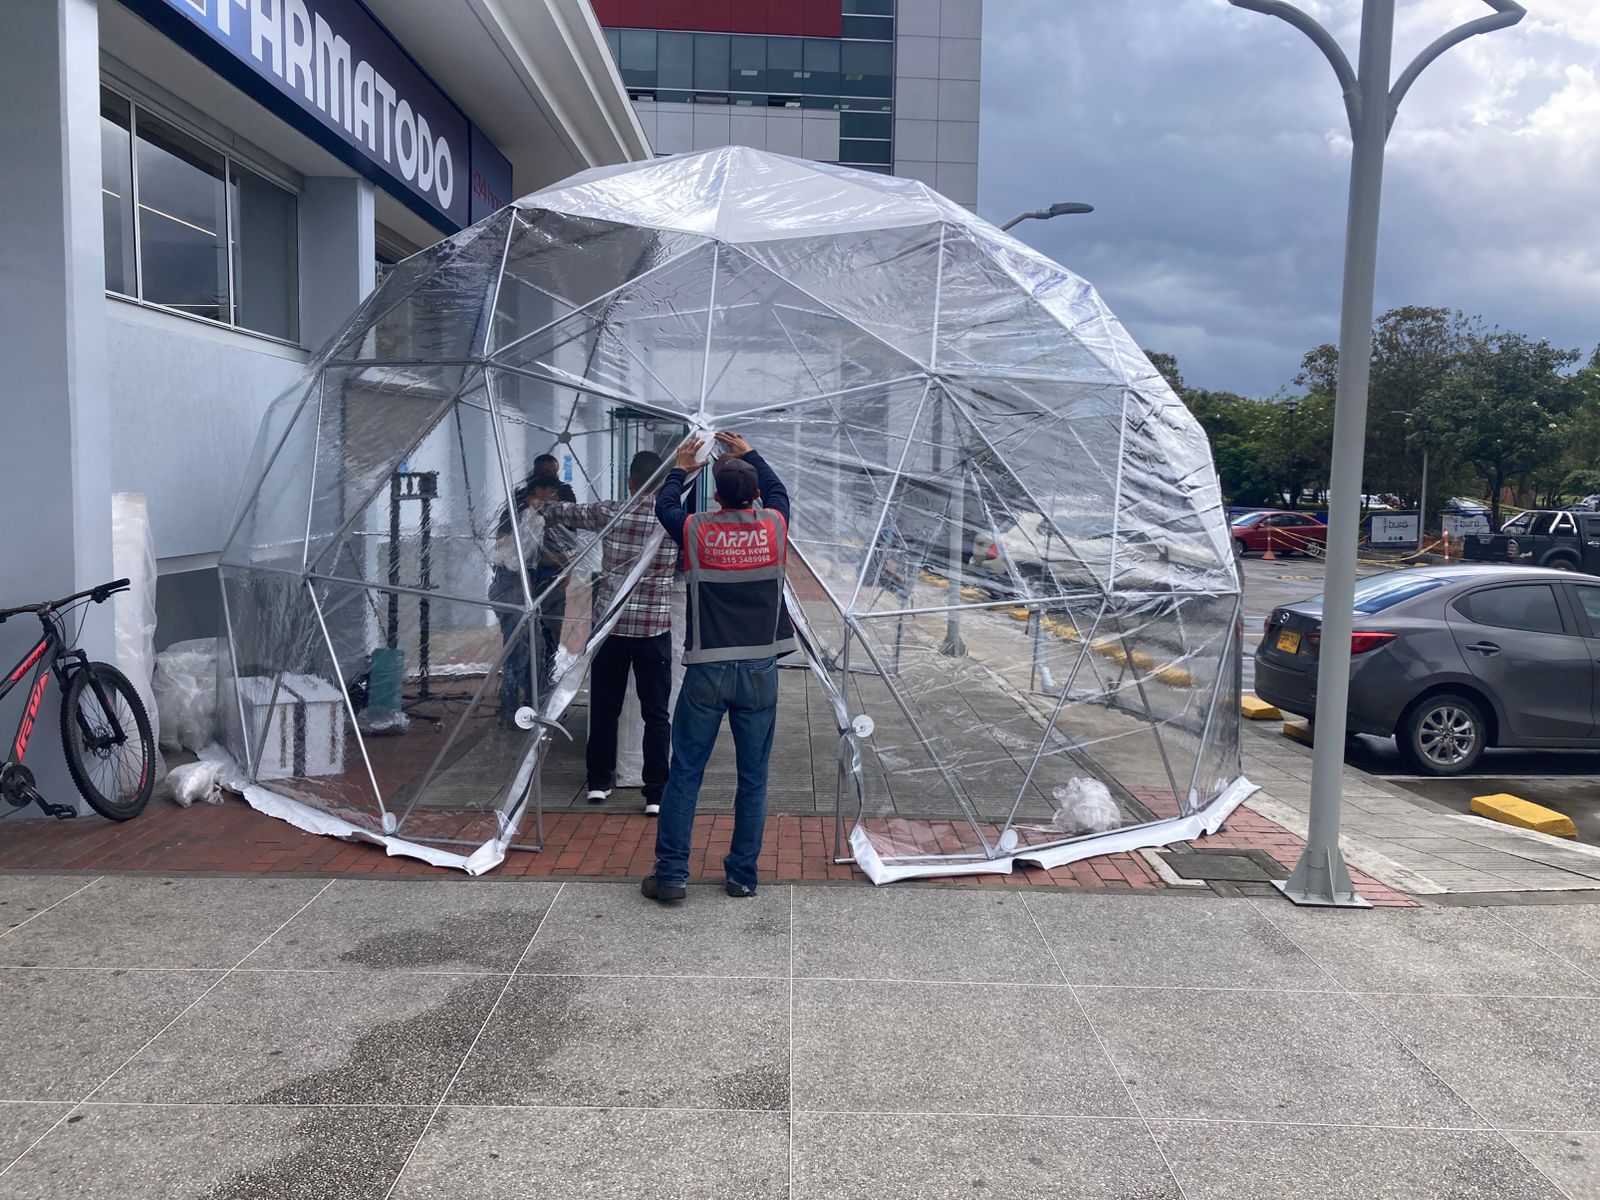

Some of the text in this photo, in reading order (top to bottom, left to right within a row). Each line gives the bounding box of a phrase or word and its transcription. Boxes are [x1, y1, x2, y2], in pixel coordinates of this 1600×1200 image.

[217, 0, 454, 210] ARMATODO
[704, 529, 768, 547] CARPAS
[748, 546, 770, 555] KEVIN
[721, 555, 738, 564] 315
